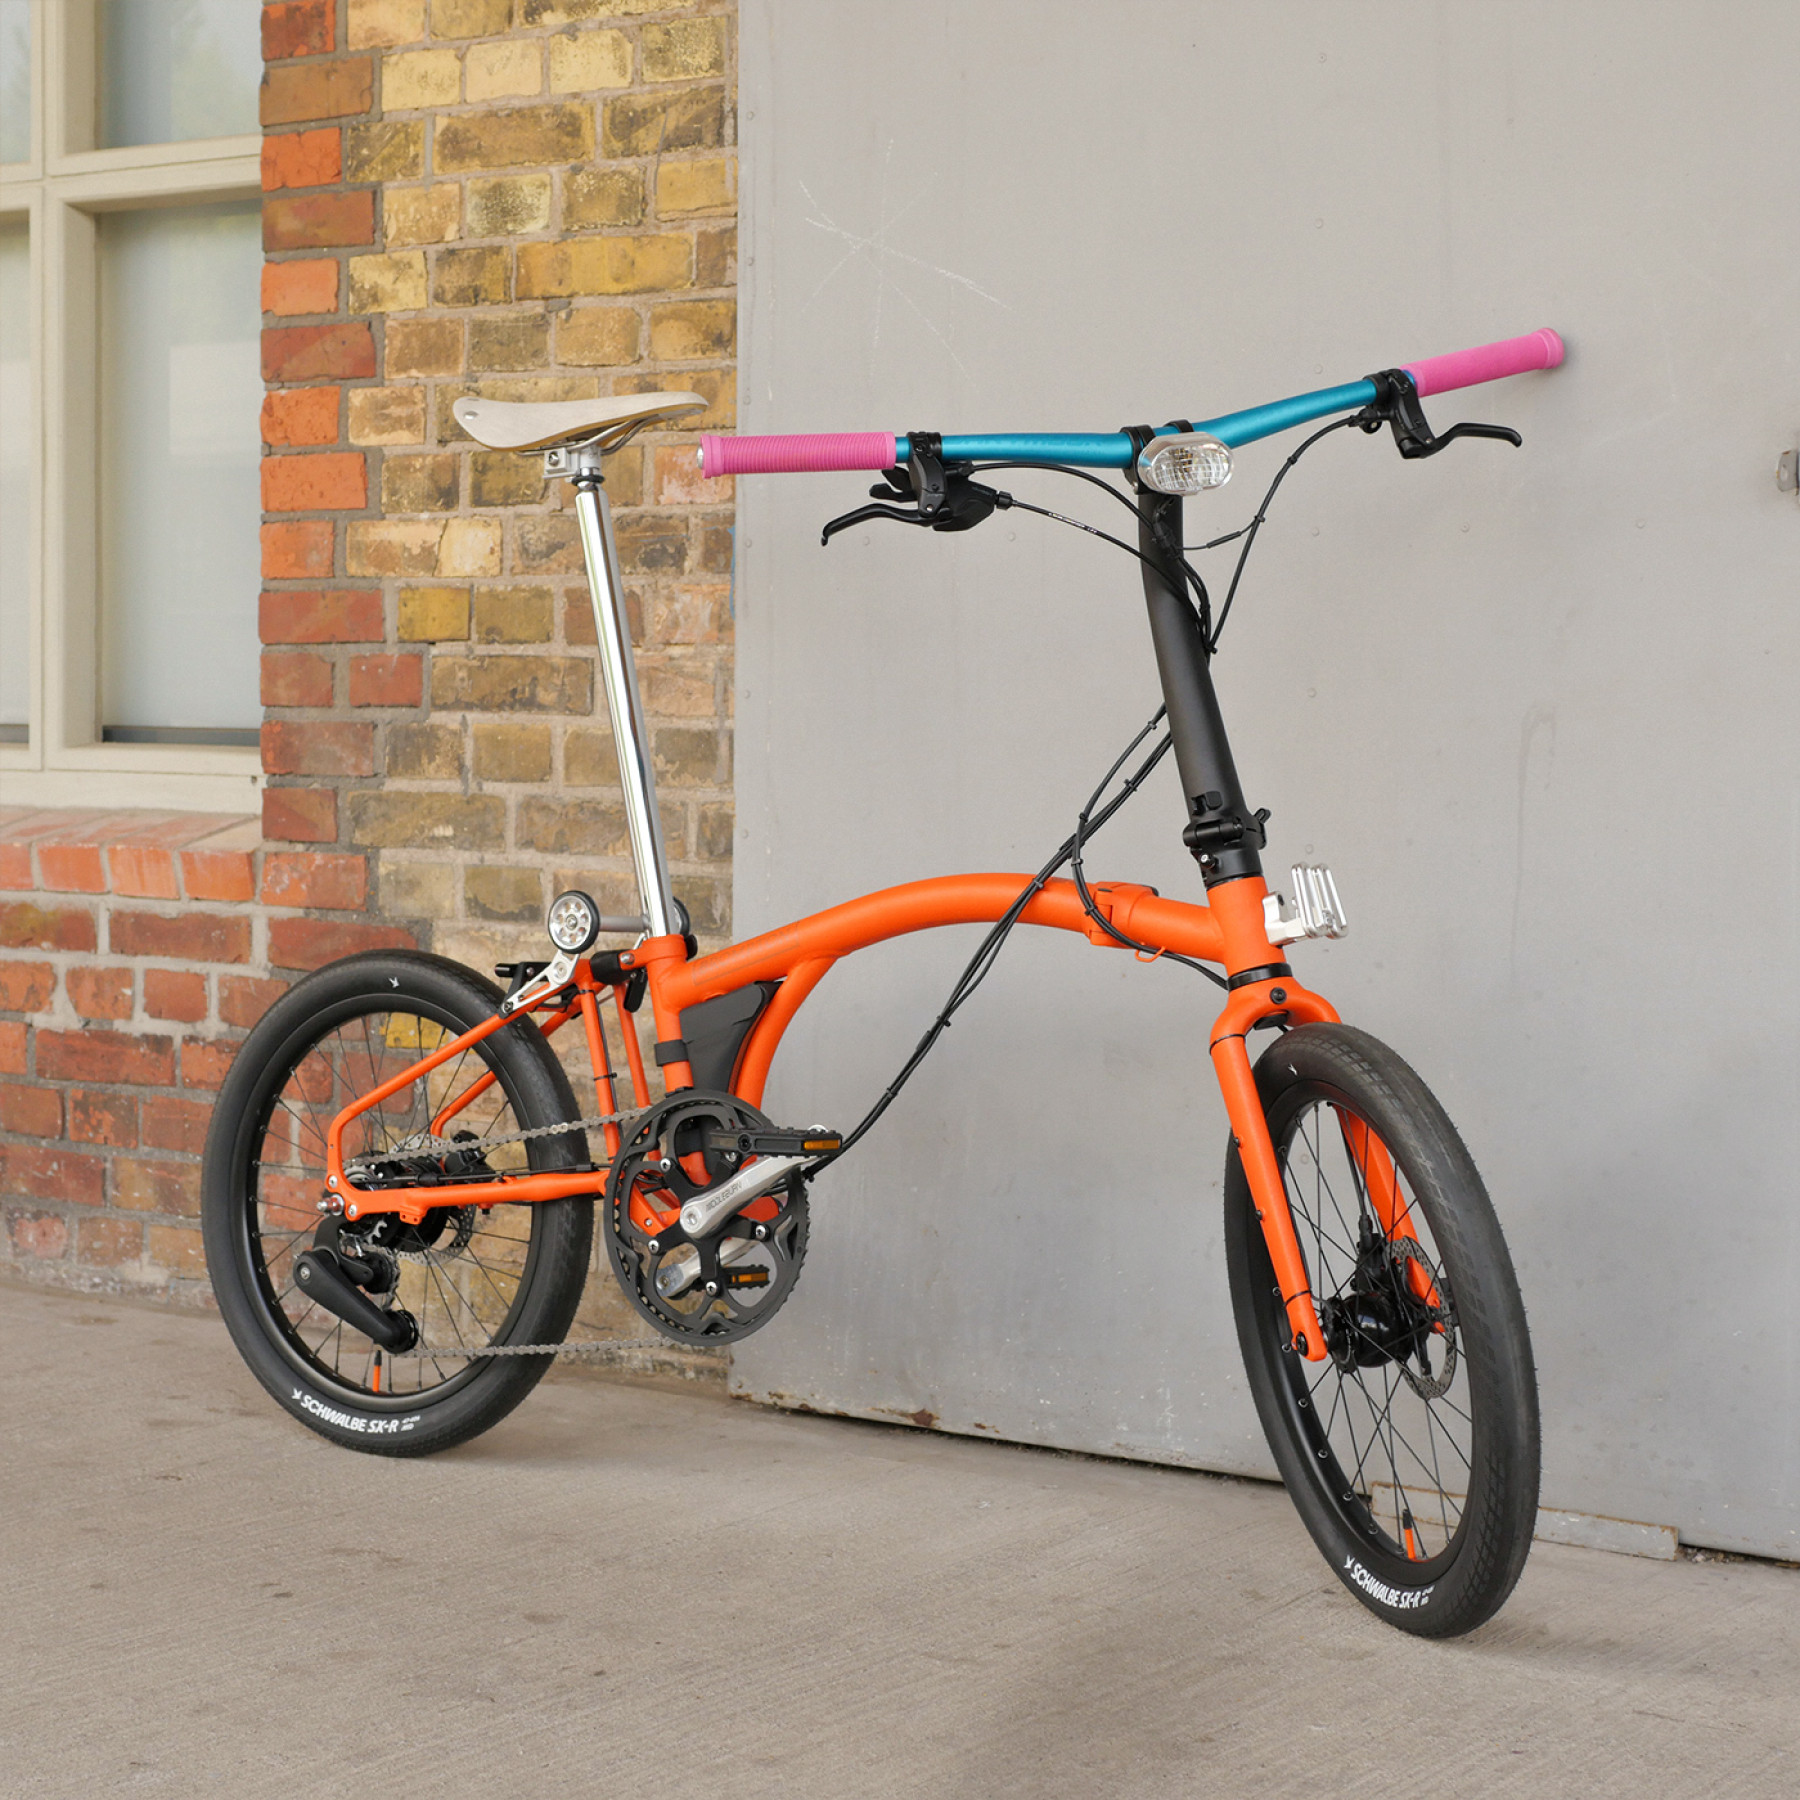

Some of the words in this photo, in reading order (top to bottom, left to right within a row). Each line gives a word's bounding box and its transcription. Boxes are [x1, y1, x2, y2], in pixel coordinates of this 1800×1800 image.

[300, 1394, 366, 1432] SCHWALBE
[367, 1419, 399, 1433] SX-R
[1350, 1562, 1401, 1608] SCHWALBE
[1399, 1591, 1421, 1609] SX-R
